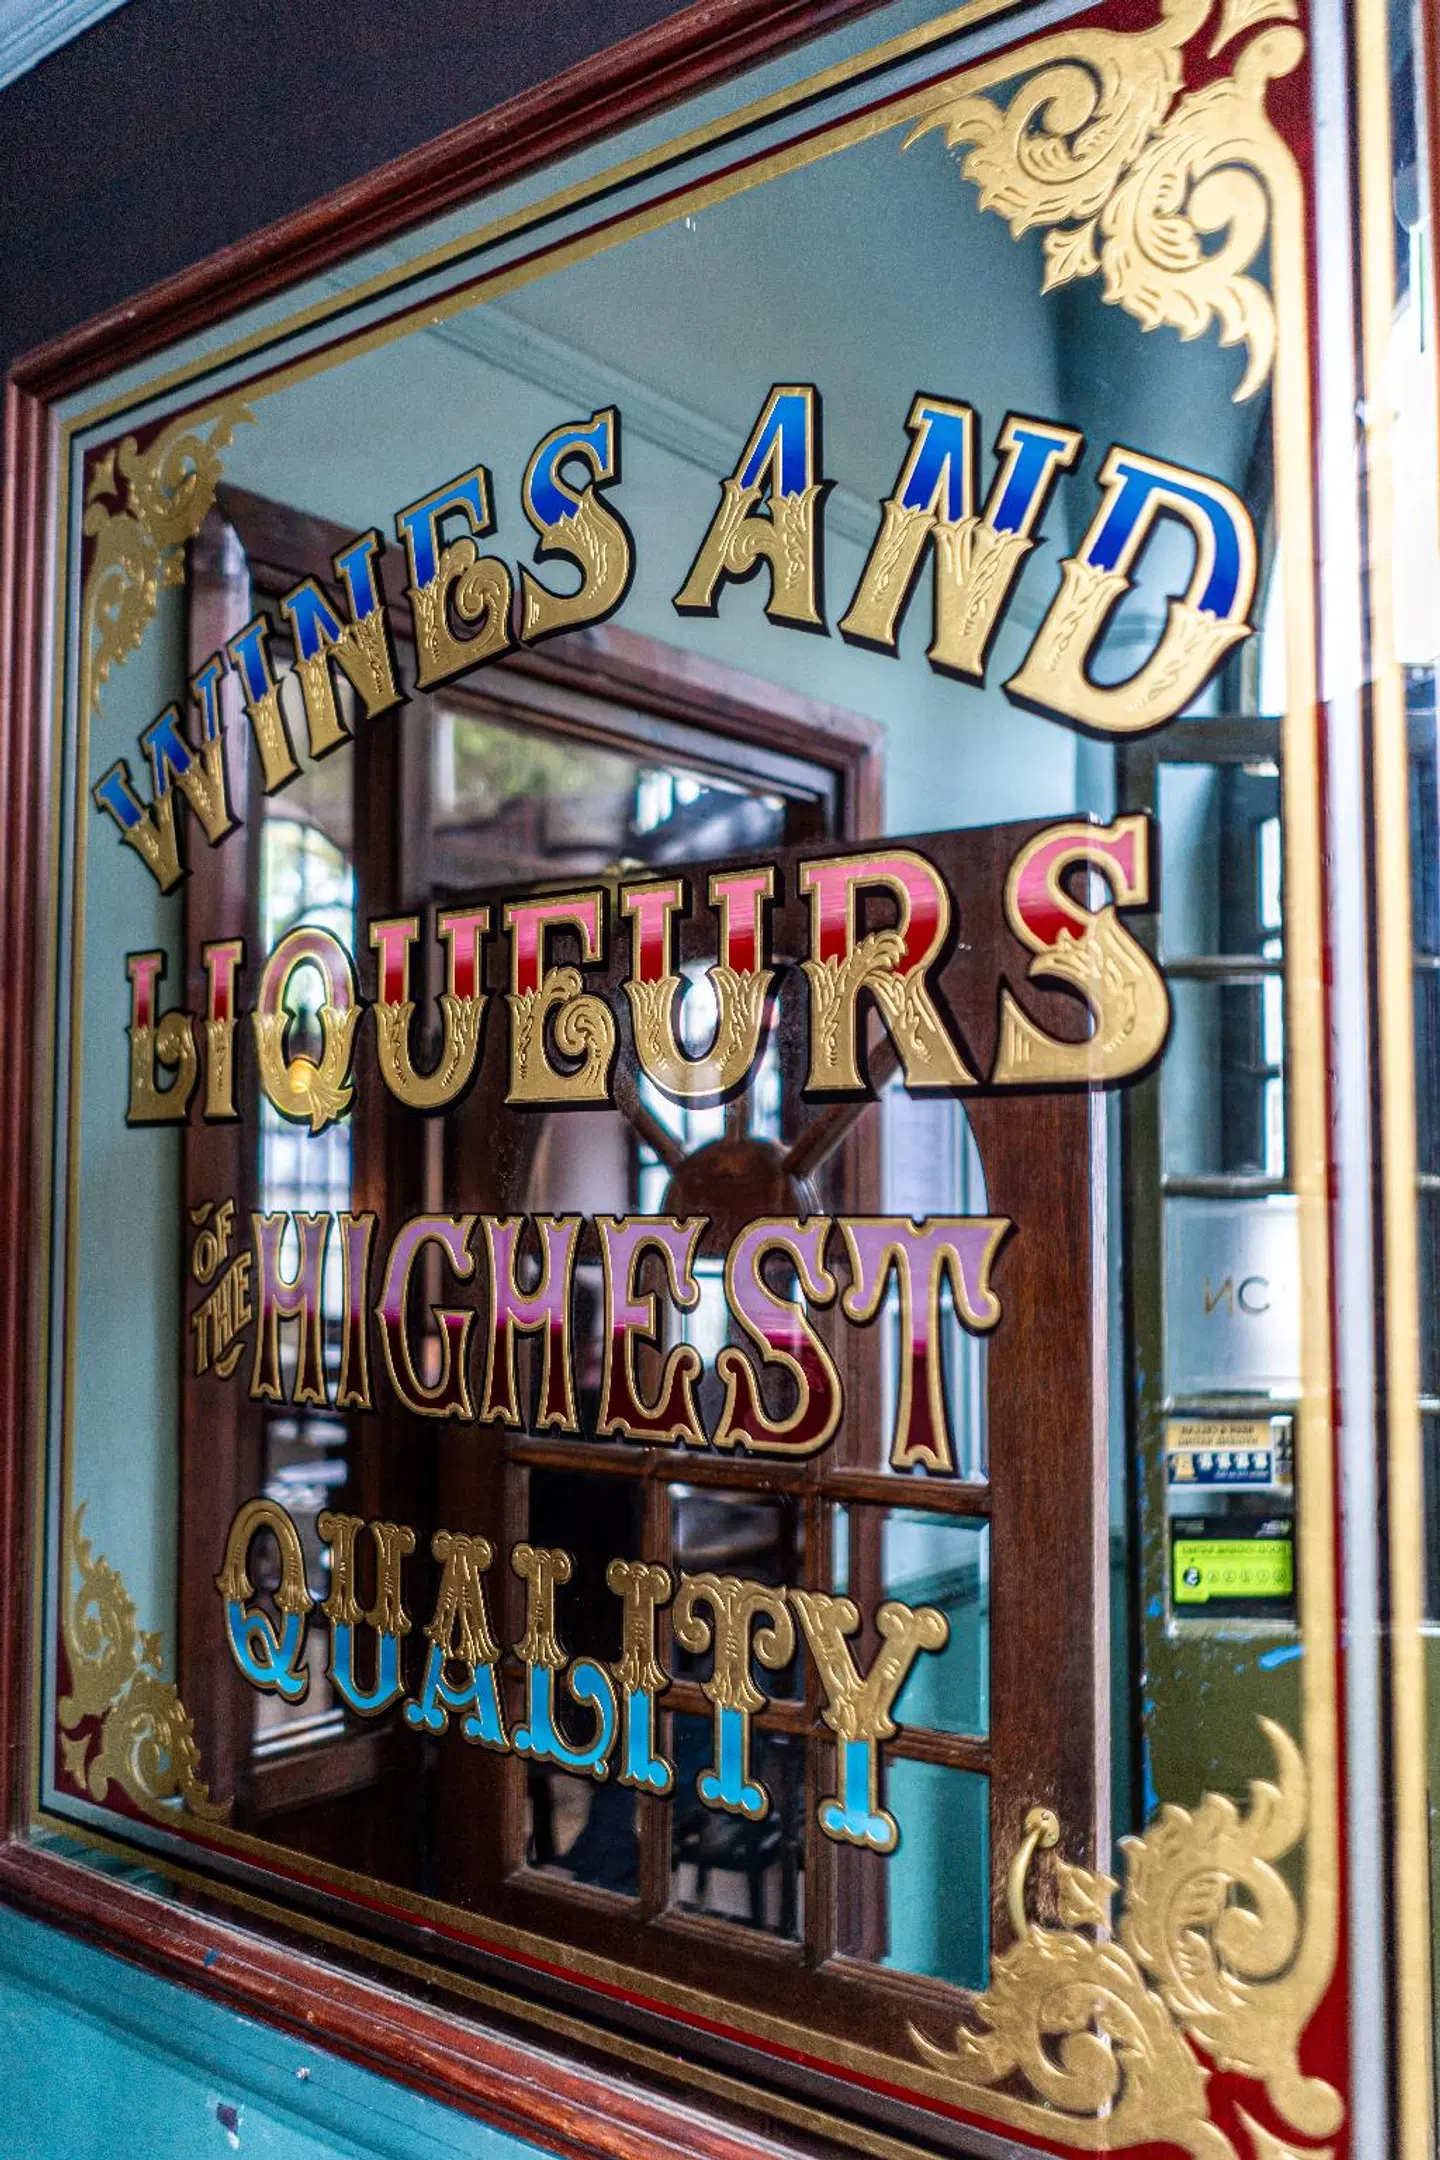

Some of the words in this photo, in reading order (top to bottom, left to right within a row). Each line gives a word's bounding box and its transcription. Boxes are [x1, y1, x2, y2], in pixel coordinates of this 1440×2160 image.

[93, 405, 636, 896] WINES
[674, 383, 1259, 742] AND
[126, 810, 1173, 1136] LIQUEURS
[191, 1250, 252, 1376] THE
[192, 1199, 235, 1285] OF
[249, 1212, 1017, 1477] HIGHEST
[215, 1497, 951, 1854] QUALITY
